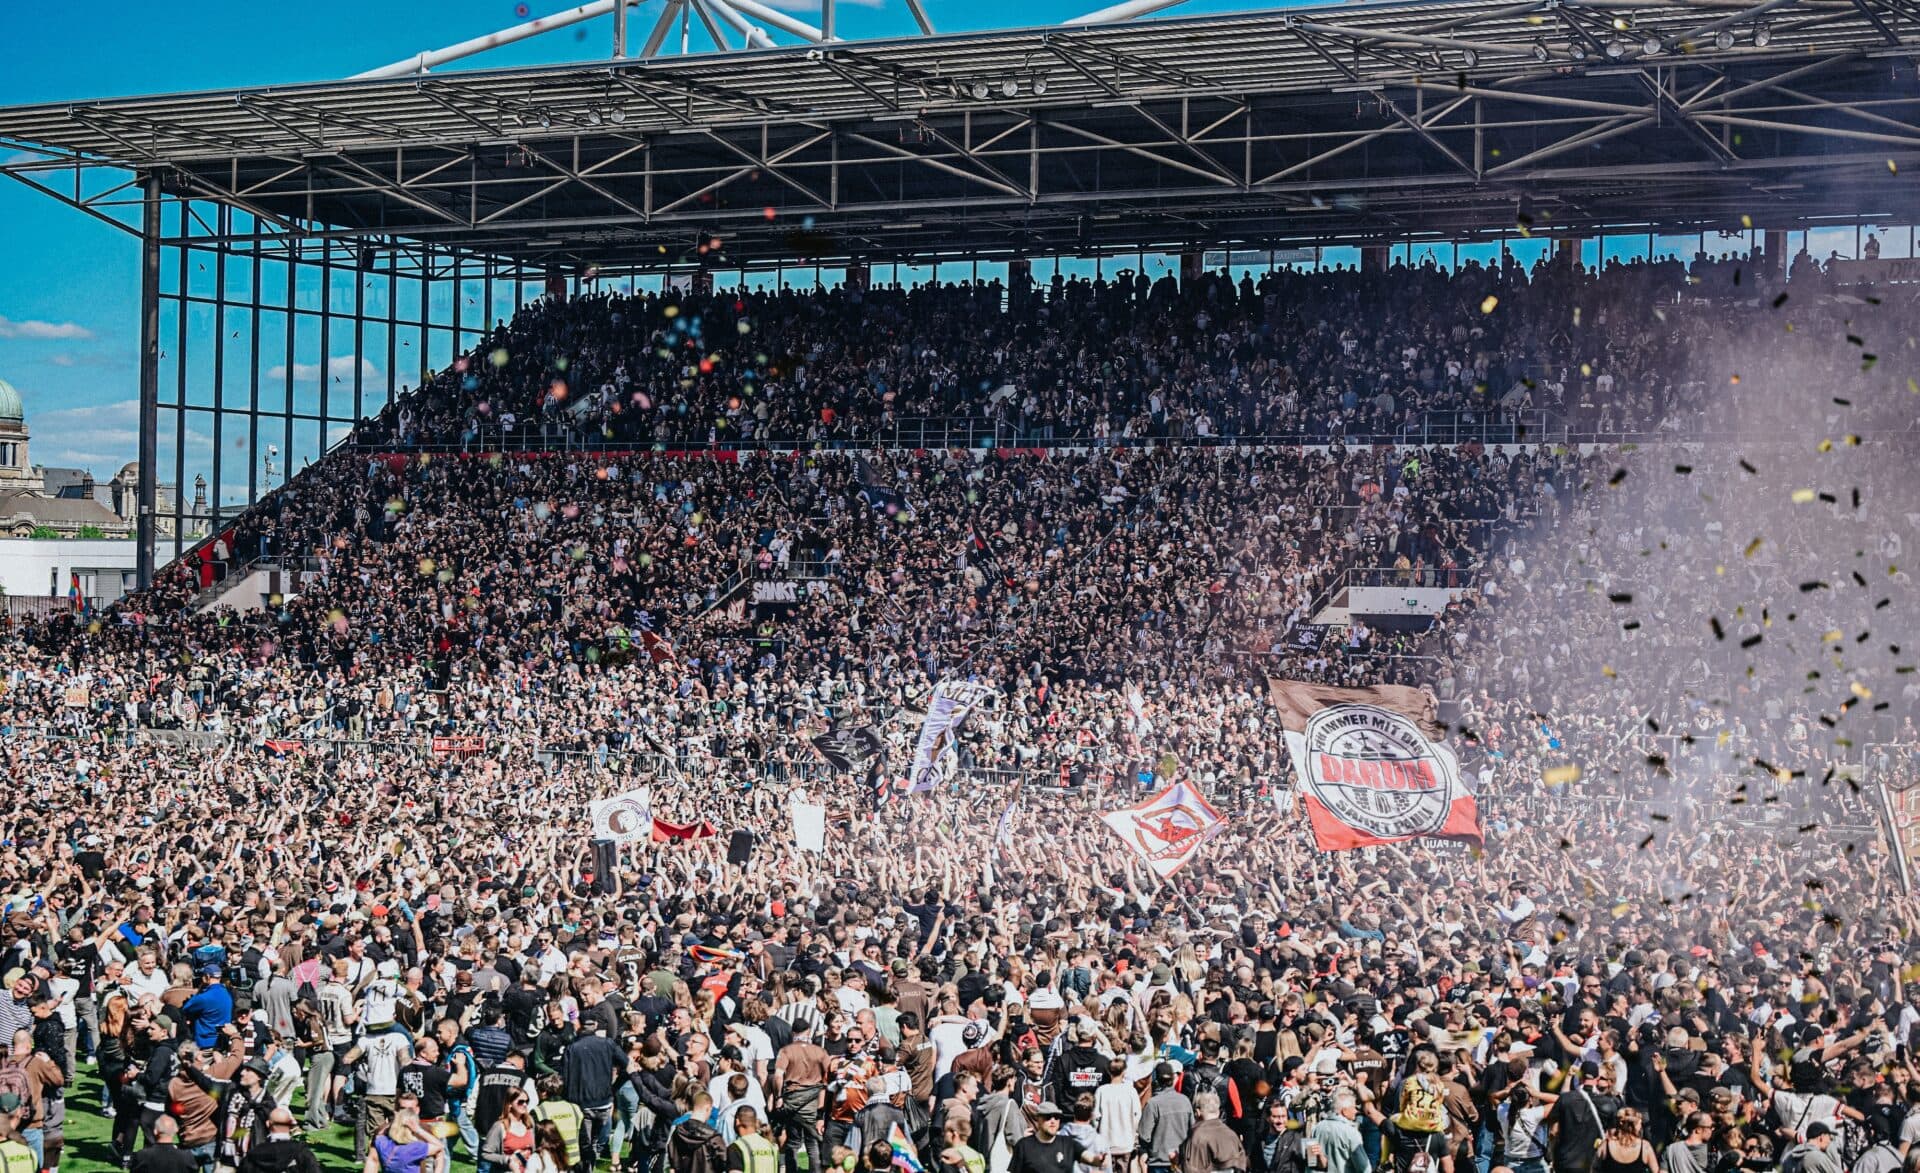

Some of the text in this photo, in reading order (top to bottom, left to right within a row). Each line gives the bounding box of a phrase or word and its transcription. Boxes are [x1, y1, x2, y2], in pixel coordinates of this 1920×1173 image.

[1321, 713, 1369, 735] IMMER
[1372, 715, 1401, 737] MIT
[1400, 731, 1425, 757] DIR
[1320, 752, 1437, 791] DARUM
[1335, 798, 1435, 834] SANKT PAULI
